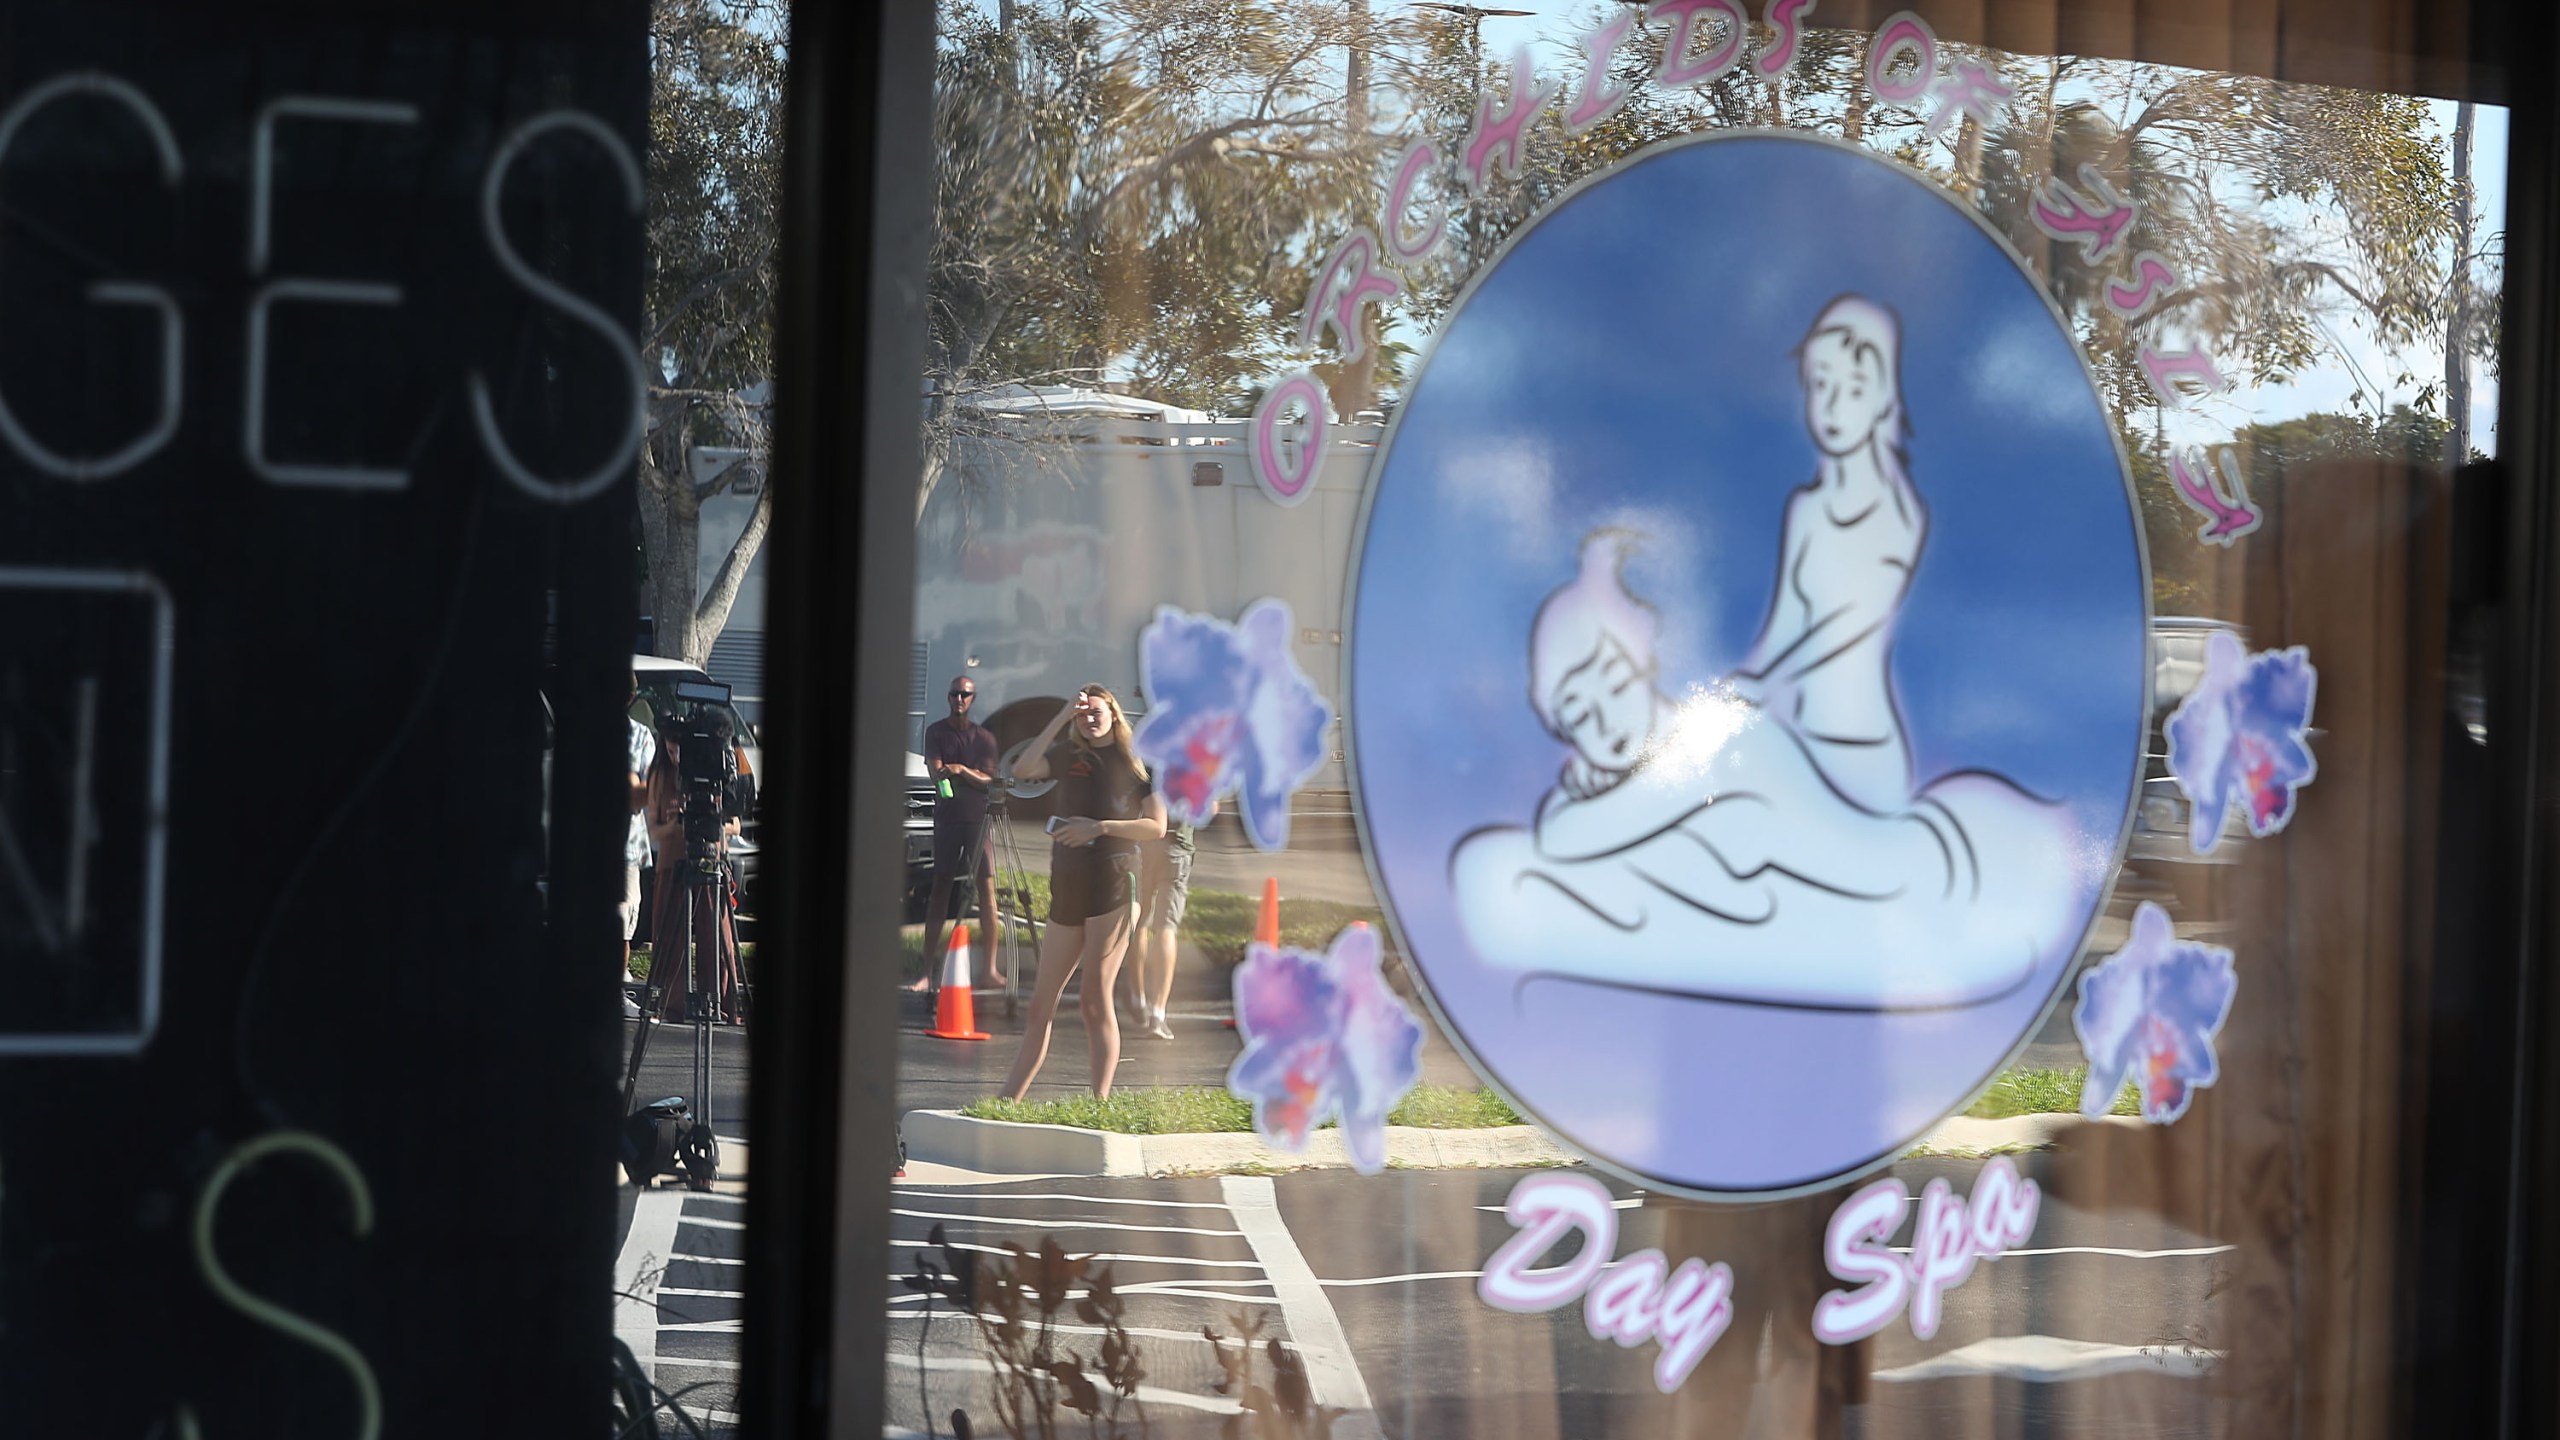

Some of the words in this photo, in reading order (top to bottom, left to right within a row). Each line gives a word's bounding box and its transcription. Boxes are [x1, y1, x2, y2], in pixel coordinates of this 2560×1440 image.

[1252, 0, 1808, 502] ORCHIDS
[1869, 13, 2017, 139] OF
[1480, 1173, 1733, 1391] Day
[1814, 1159, 2038, 1342] Spa
